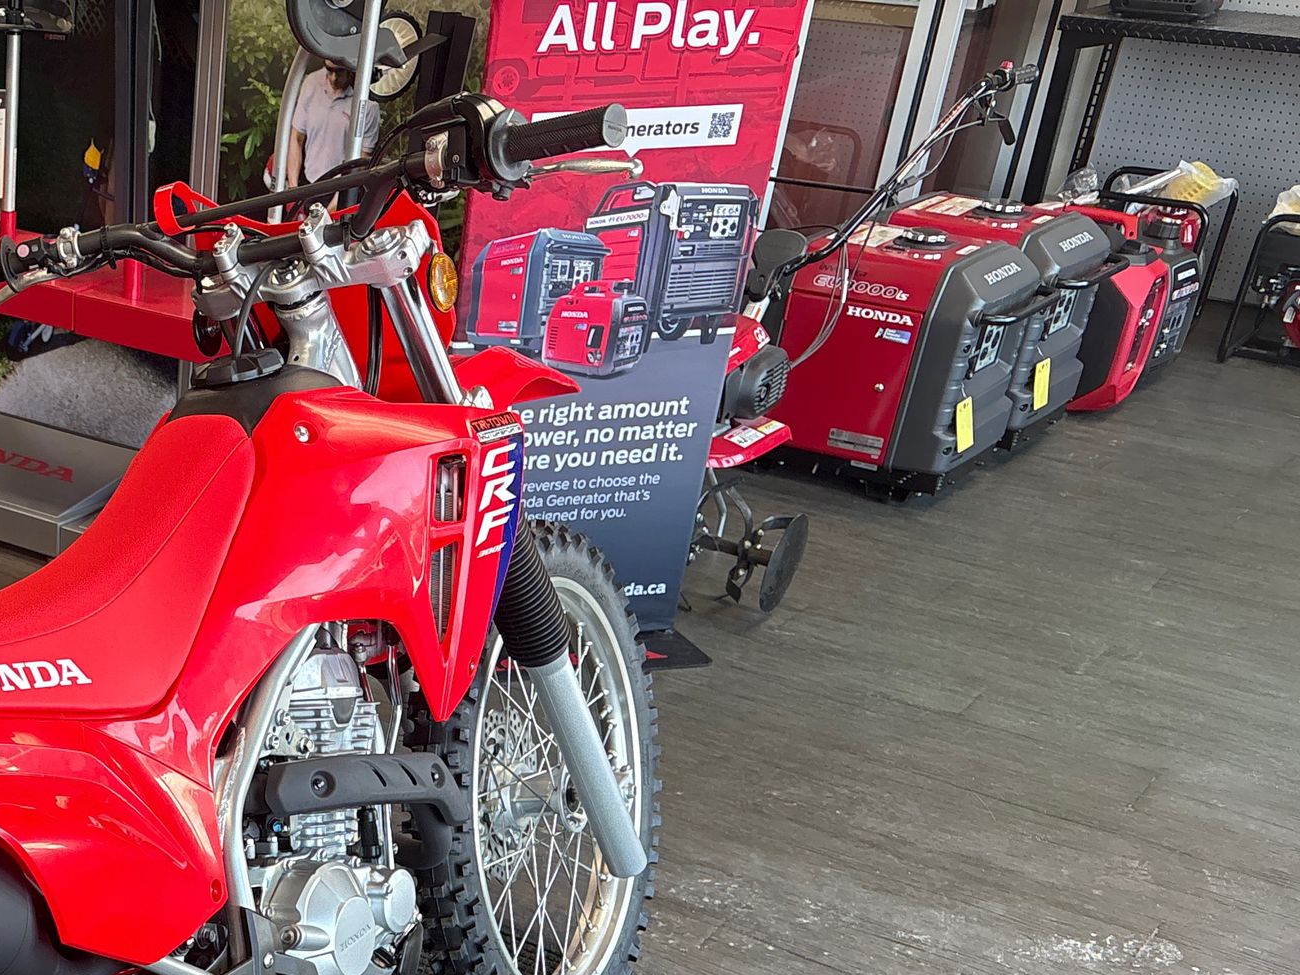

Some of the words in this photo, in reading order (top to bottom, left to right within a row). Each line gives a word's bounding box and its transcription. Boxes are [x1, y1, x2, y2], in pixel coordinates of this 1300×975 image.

[536, 0, 616, 54] All
[630, 0, 761, 58] Play.
[625, 119, 700, 138] nerators
[1059, 231, 1094, 252] HONDA
[984, 262, 1022, 285] HONDA
[846, 306, 914, 326] HONDA
[538, 402, 595, 427] right
[598, 396, 690, 423] amount
[524, 429, 579, 448] ower,
[586, 428, 613, 443] no
[617, 420, 698, 441] matter
[554, 450, 596, 472] you
[600, 444, 656, 464] need
[660, 442, 684, 462] it.
[573, 478, 587, 489] to
[589, 473, 637, 488] choose
[640, 472, 661, 485] the
[546, 491, 612, 507] Generator
[614, 489, 651, 502] that's
[580, 508, 599, 520] for
[600, 507, 627, 521] you.
[623, 581, 667, 597] da.ca
[339, 923, 373, 953] HONDA
